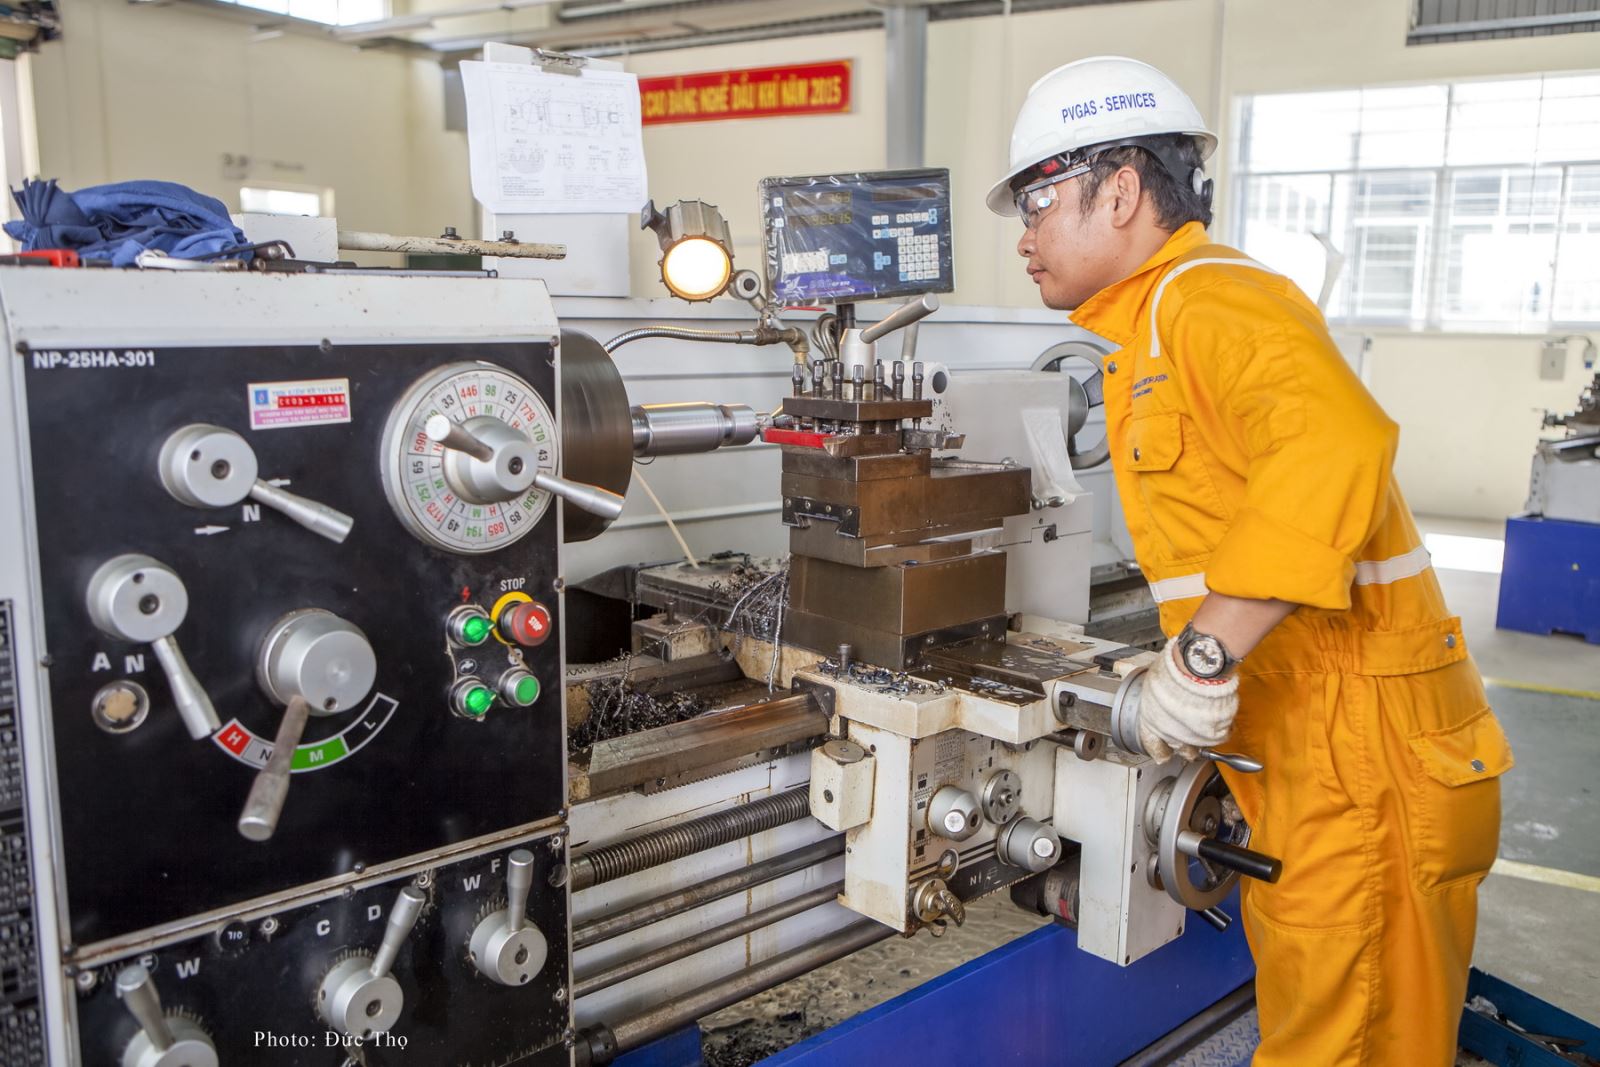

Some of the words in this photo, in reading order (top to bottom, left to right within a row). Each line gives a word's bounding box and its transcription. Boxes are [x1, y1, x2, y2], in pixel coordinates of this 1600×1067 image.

[810, 76, 842, 105] 2015
[1061, 99, 1097, 123] PVGAS
[1105, 92, 1156, 112] SERVICES
[33, 350, 155, 369] NP-25HA-301
[460, 385, 478, 399] 446
[485, 384, 496, 397] 98
[504, 390, 518, 405] 25
[441, 394, 455, 409] 33
[468, 405, 476, 416] H
[484, 404, 493, 414] M
[520, 402, 536, 422] 779
[532, 423, 546, 442] 170
[414, 432, 428, 453] 590
[538, 449, 548, 461] 43
[412, 460, 424, 474] 65
[416, 483, 432, 502] 257
[242, 504, 261, 522] N
[426, 502, 445, 523] 1173
[509, 510, 522, 525] 85
[447, 519, 460, 532] 49
[488, 521, 505, 537] 885
[500, 577, 526, 591] STOP
[528, 615, 543, 632] STOP
[92, 651, 112, 672] A
[125, 653, 145, 674] N
[227, 731, 242, 746] H
[309, 749, 324, 763] M
[363, 720, 376, 730] L
[463, 874, 482, 892] W
[490, 858, 501, 873] F
[316, 919, 331, 937] C
[367, 904, 382, 921] D
[176, 957, 201, 979] W
